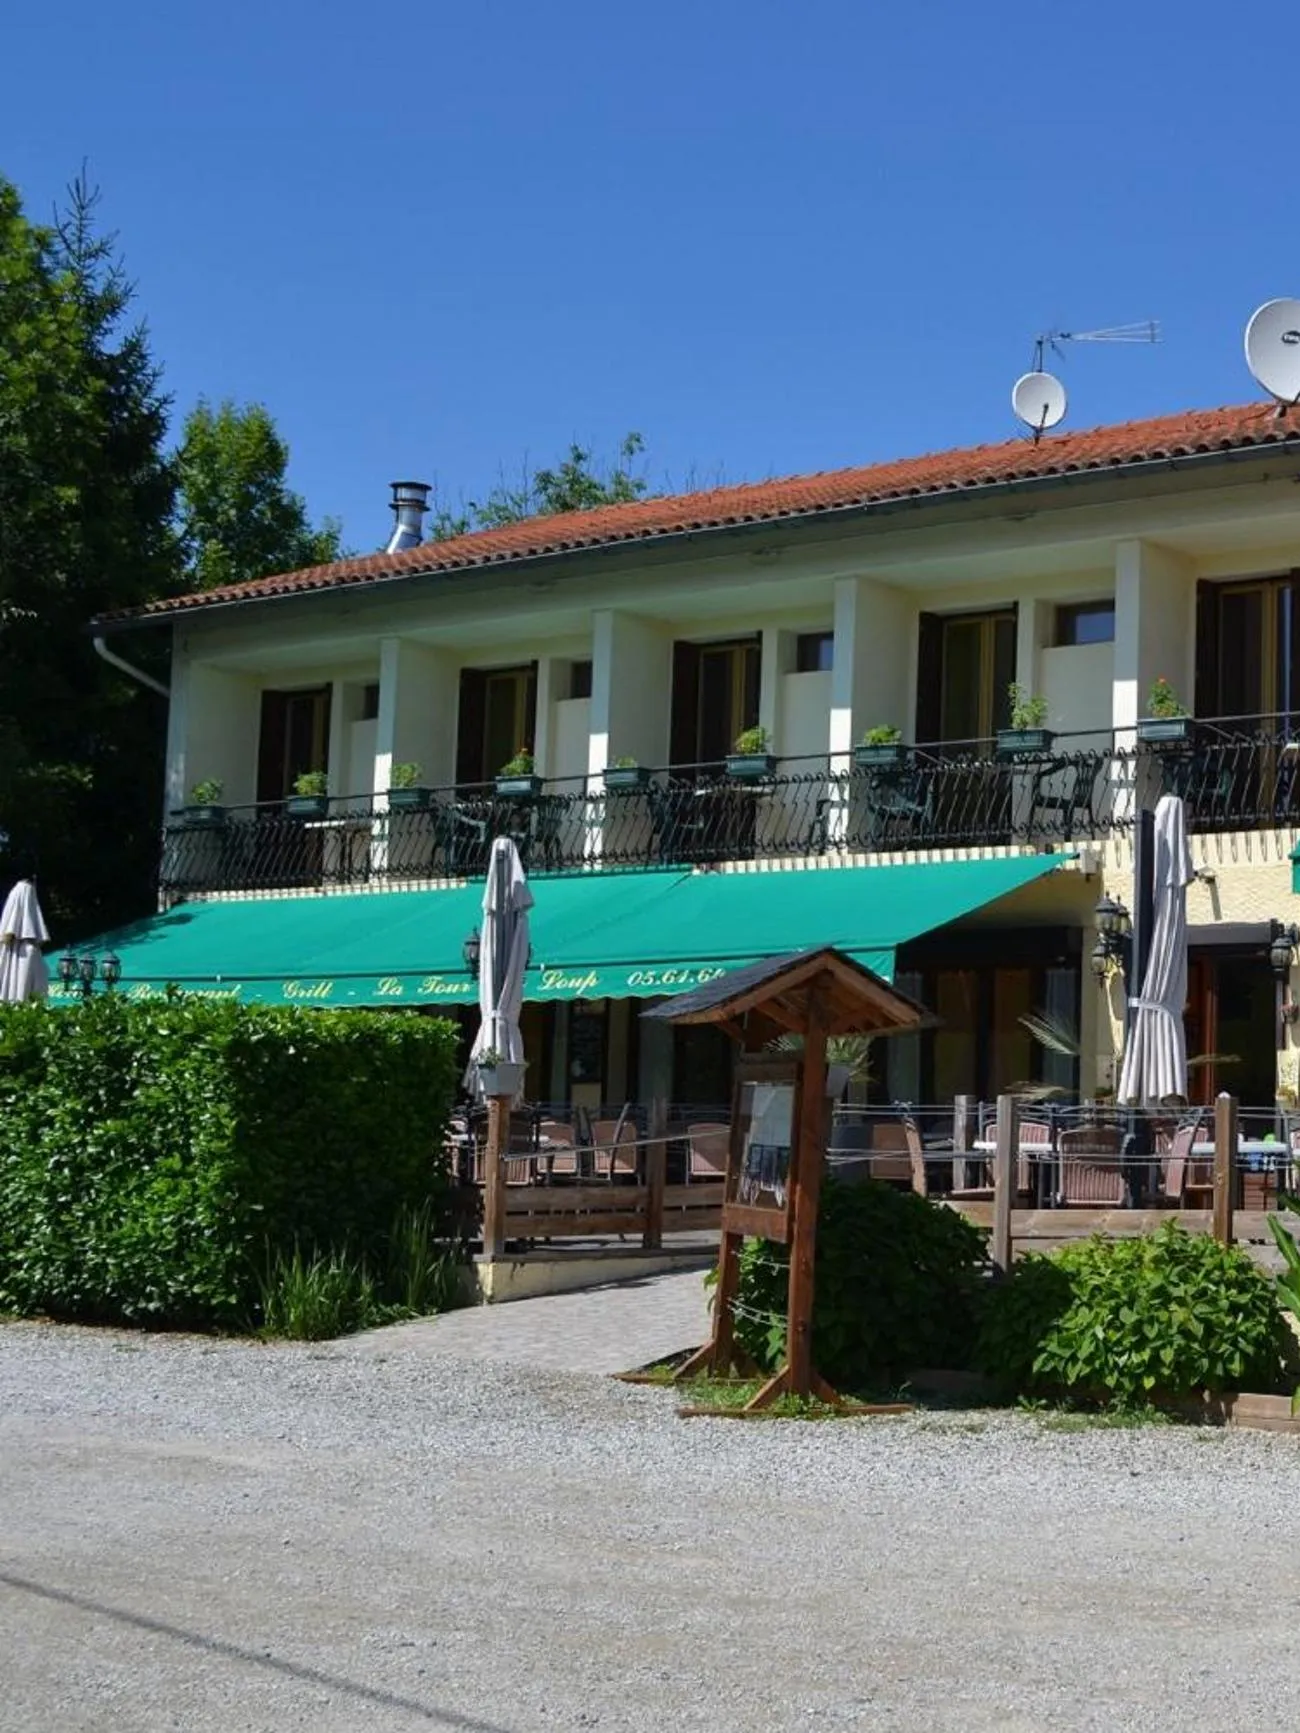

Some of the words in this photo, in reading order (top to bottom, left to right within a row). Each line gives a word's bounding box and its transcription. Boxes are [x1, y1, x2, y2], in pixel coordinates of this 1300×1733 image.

[283, 979, 333, 999] Grill
[373, 976, 403, 995] La
[417, 975, 472, 994] Tour
[538, 970, 599, 995] Loup
